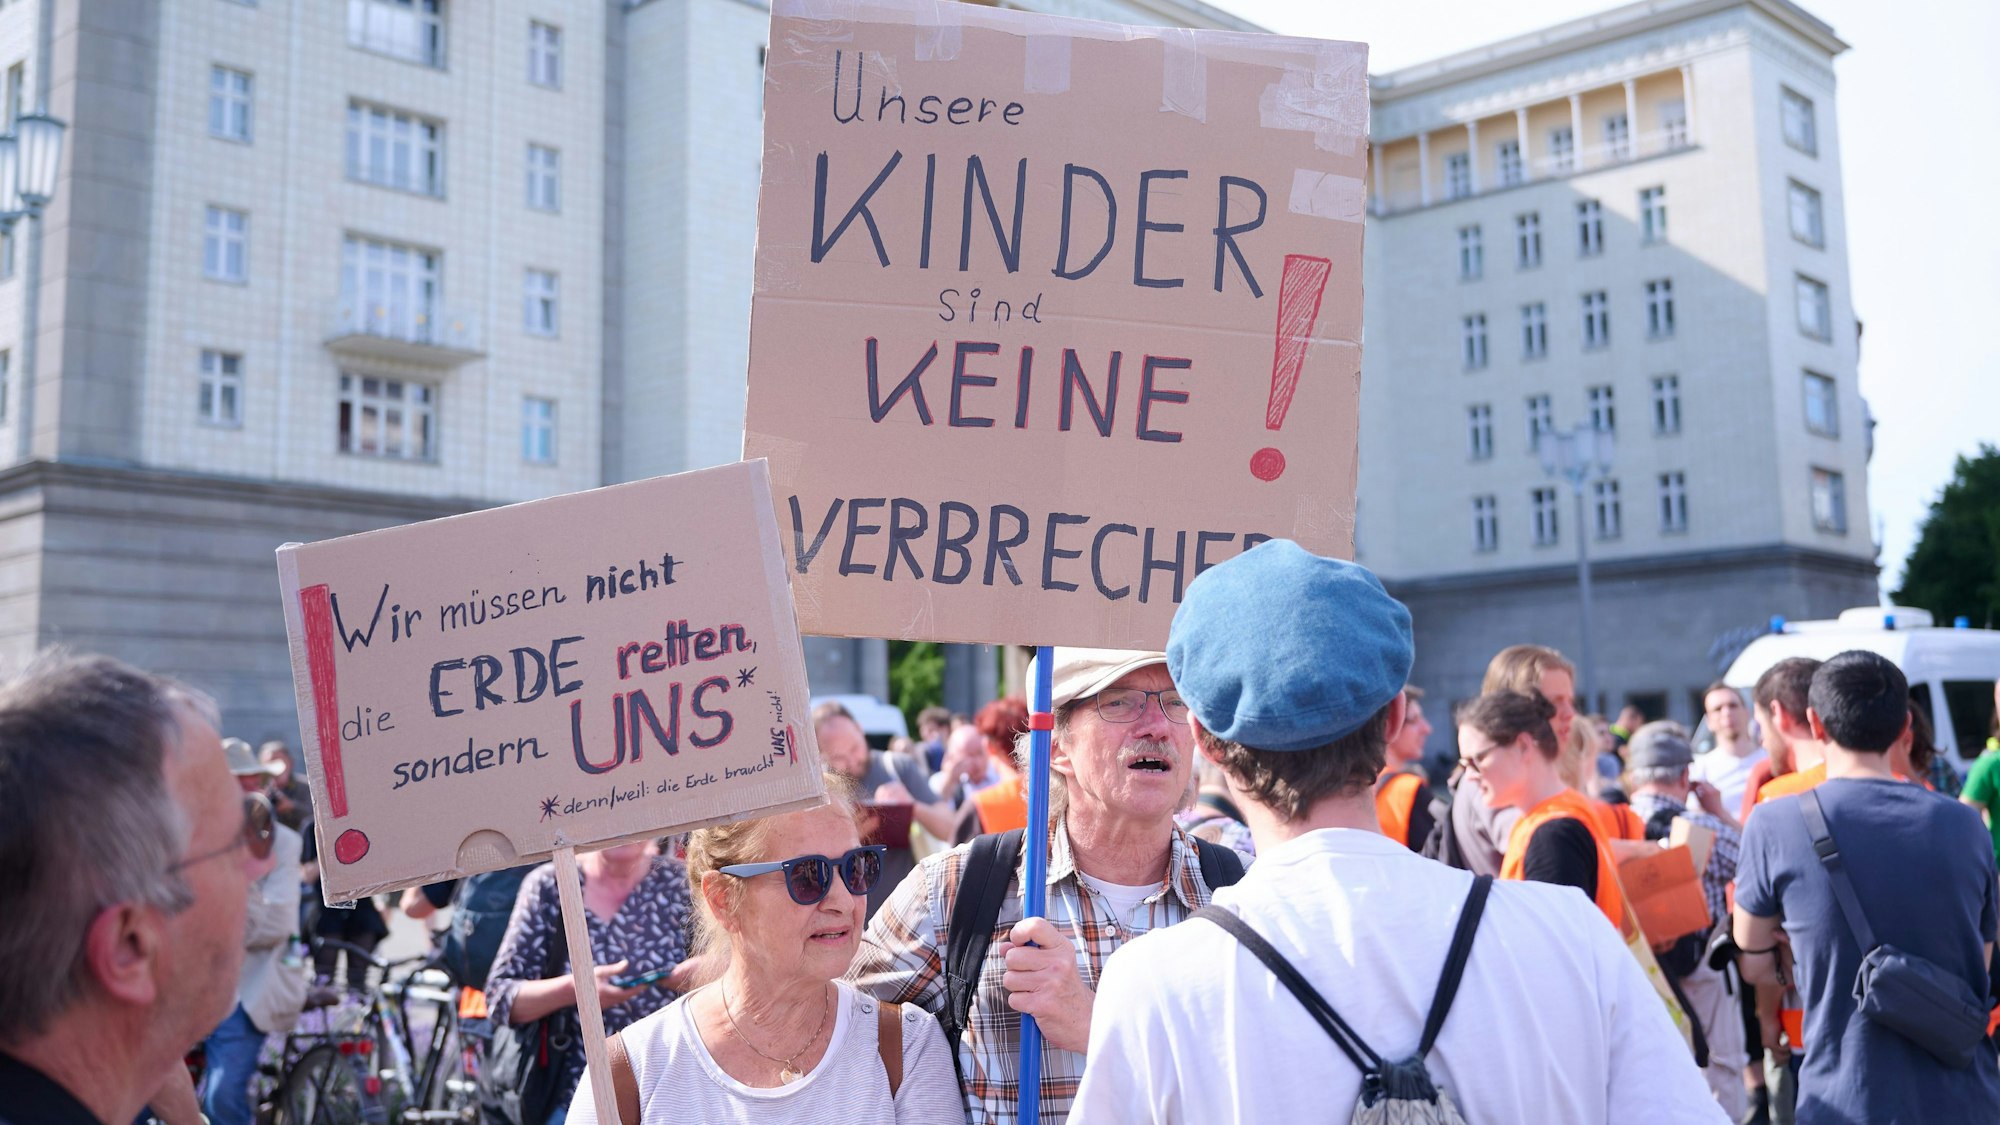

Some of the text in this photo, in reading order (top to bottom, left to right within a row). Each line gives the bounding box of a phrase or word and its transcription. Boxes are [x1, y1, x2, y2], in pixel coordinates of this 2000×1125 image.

[832, 49, 1026, 125] Unsere
[810, 149, 1268, 299] KINDER
[863, 337, 1193, 443] KEINE
[788, 494, 1275, 606] VERBRECHE
[330, 552, 684, 653] Wir müssen nicht
[342, 618, 757, 741] die ERDE retten,
[392, 736, 549, 790] sondern
[656, 779, 680, 795] die
[685, 773, 718, 789] Erde
[724, 753, 775, 780] braucht
[769, 726, 786, 758] UNS
